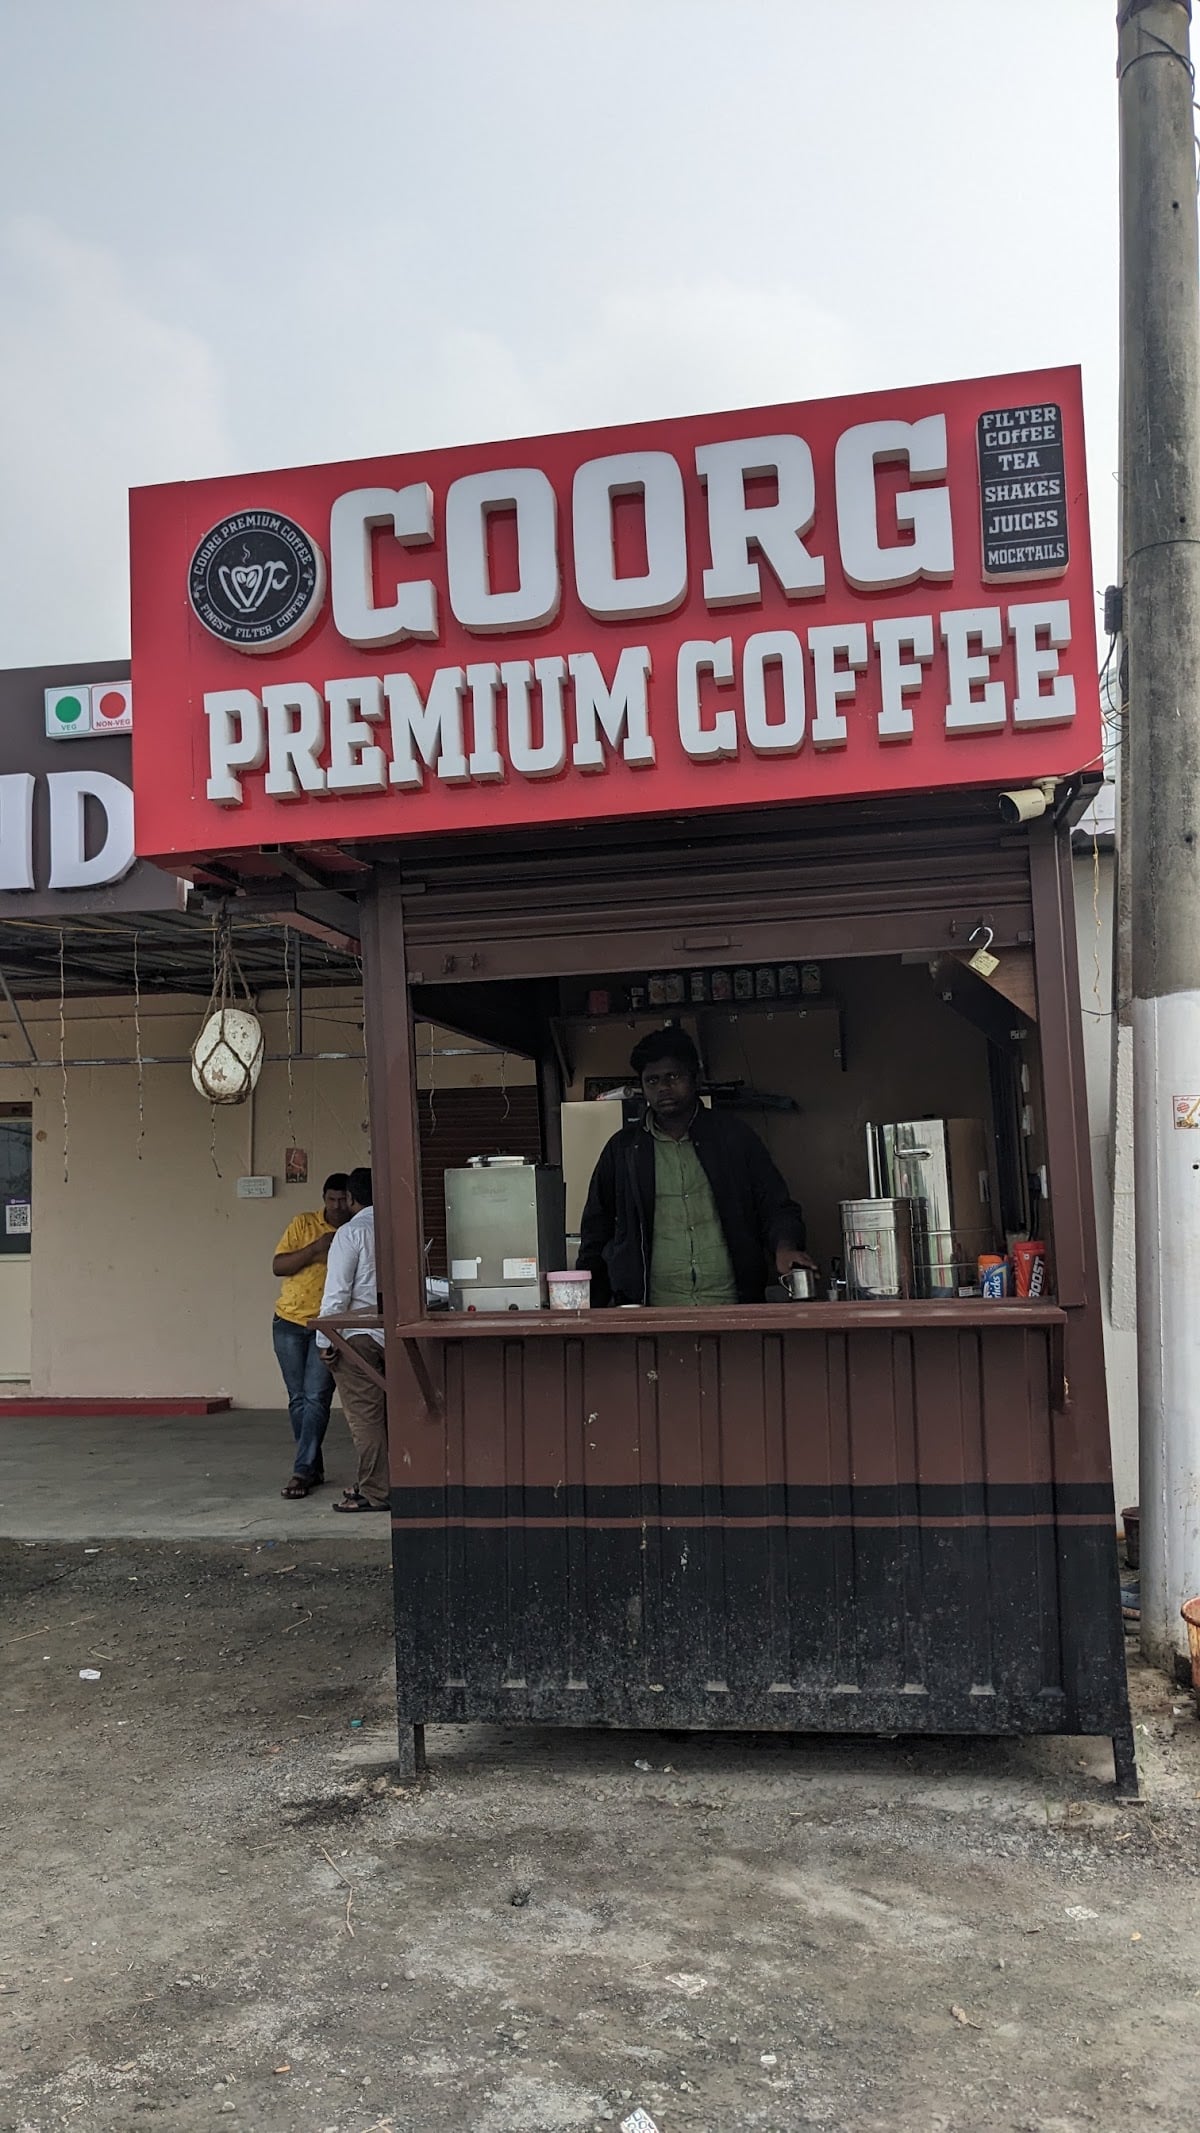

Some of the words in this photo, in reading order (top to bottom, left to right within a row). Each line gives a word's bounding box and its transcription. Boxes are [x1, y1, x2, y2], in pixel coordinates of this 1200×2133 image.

[982, 407, 1057, 429] FILTER
[998, 452, 1040, 471] TEA
[985, 479, 1060, 503] SHAKES
[330, 413, 954, 648] COORG
[988, 510, 1059, 534] JUICES
[193, 534, 222, 575] COORG
[220, 515, 281, 538] PREMIUM
[988, 543, 1065, 566] MOCKTAILS
[200, 603, 232, 633] FINEST
[235, 625, 273, 638] FILTER
[276, 592, 307, 627] COFFEE
[204, 646, 655, 804] PREMIUM
[677, 600, 1076, 761] COFFEE
[61, 723, 77, 731] VEG
[95, 718, 131, 728] NON-VEG
